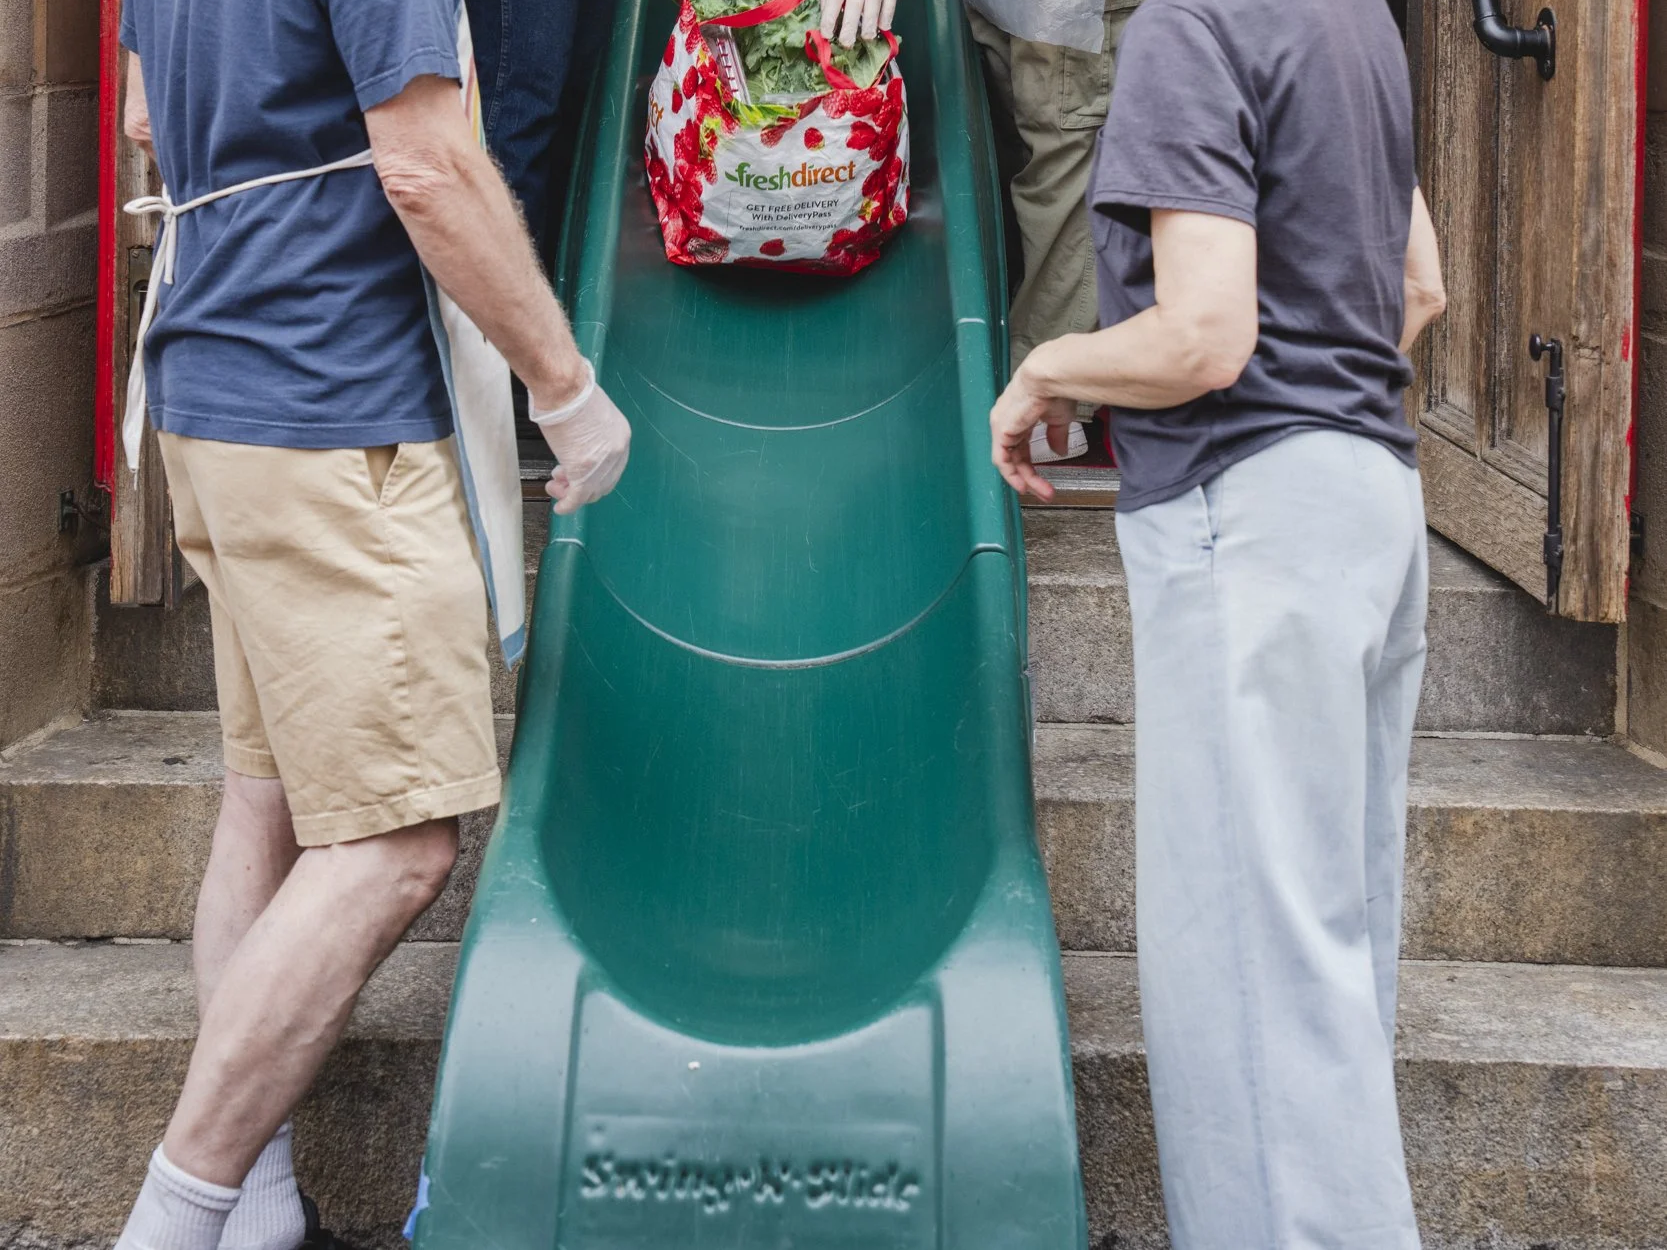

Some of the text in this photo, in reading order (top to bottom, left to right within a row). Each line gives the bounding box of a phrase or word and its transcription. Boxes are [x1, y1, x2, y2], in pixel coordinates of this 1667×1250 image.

[733, 159, 856, 191] freshdirect
[746, 199, 839, 213] GET FREE DELIVERY
[751, 211, 832, 221] With DeliveryPass
